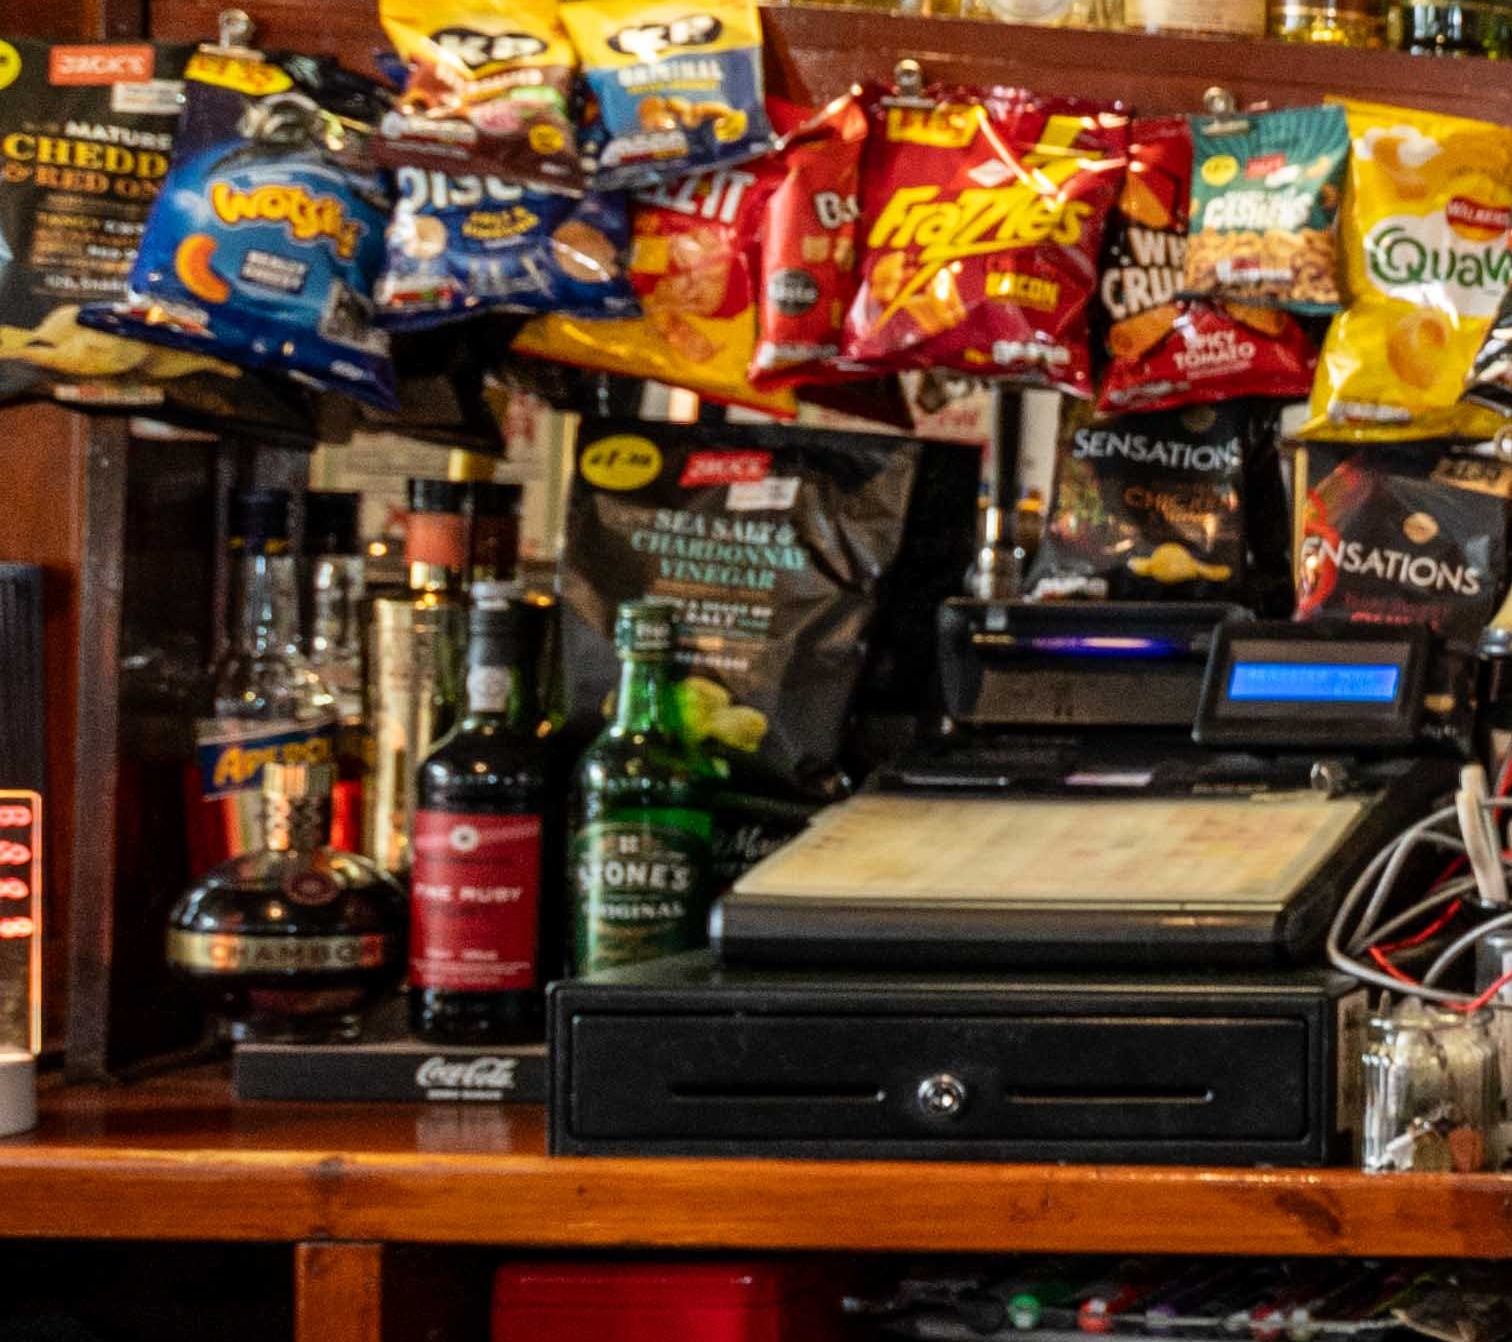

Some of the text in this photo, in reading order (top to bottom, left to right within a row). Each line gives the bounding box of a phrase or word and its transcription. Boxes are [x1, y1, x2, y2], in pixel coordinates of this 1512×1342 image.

[437, 33, 545, 63] KP
[619, 18, 715, 55] KP
[65, 121, 172, 149] MATURE
[34, 165, 108, 193] RED
[989, 274, 1057, 304] BACON
[1174, 342, 1255, 369] TOMATO
[1074, 429, 1243, 470] SENSATIONS
[656, 509, 705, 536] SEA
[711, 517, 775, 545] SALT
[660, 559, 775, 589] VINEGAR
[460, 886, 522, 902] RUBY
[416, 1058, 519, 1089] Coca-Cola
